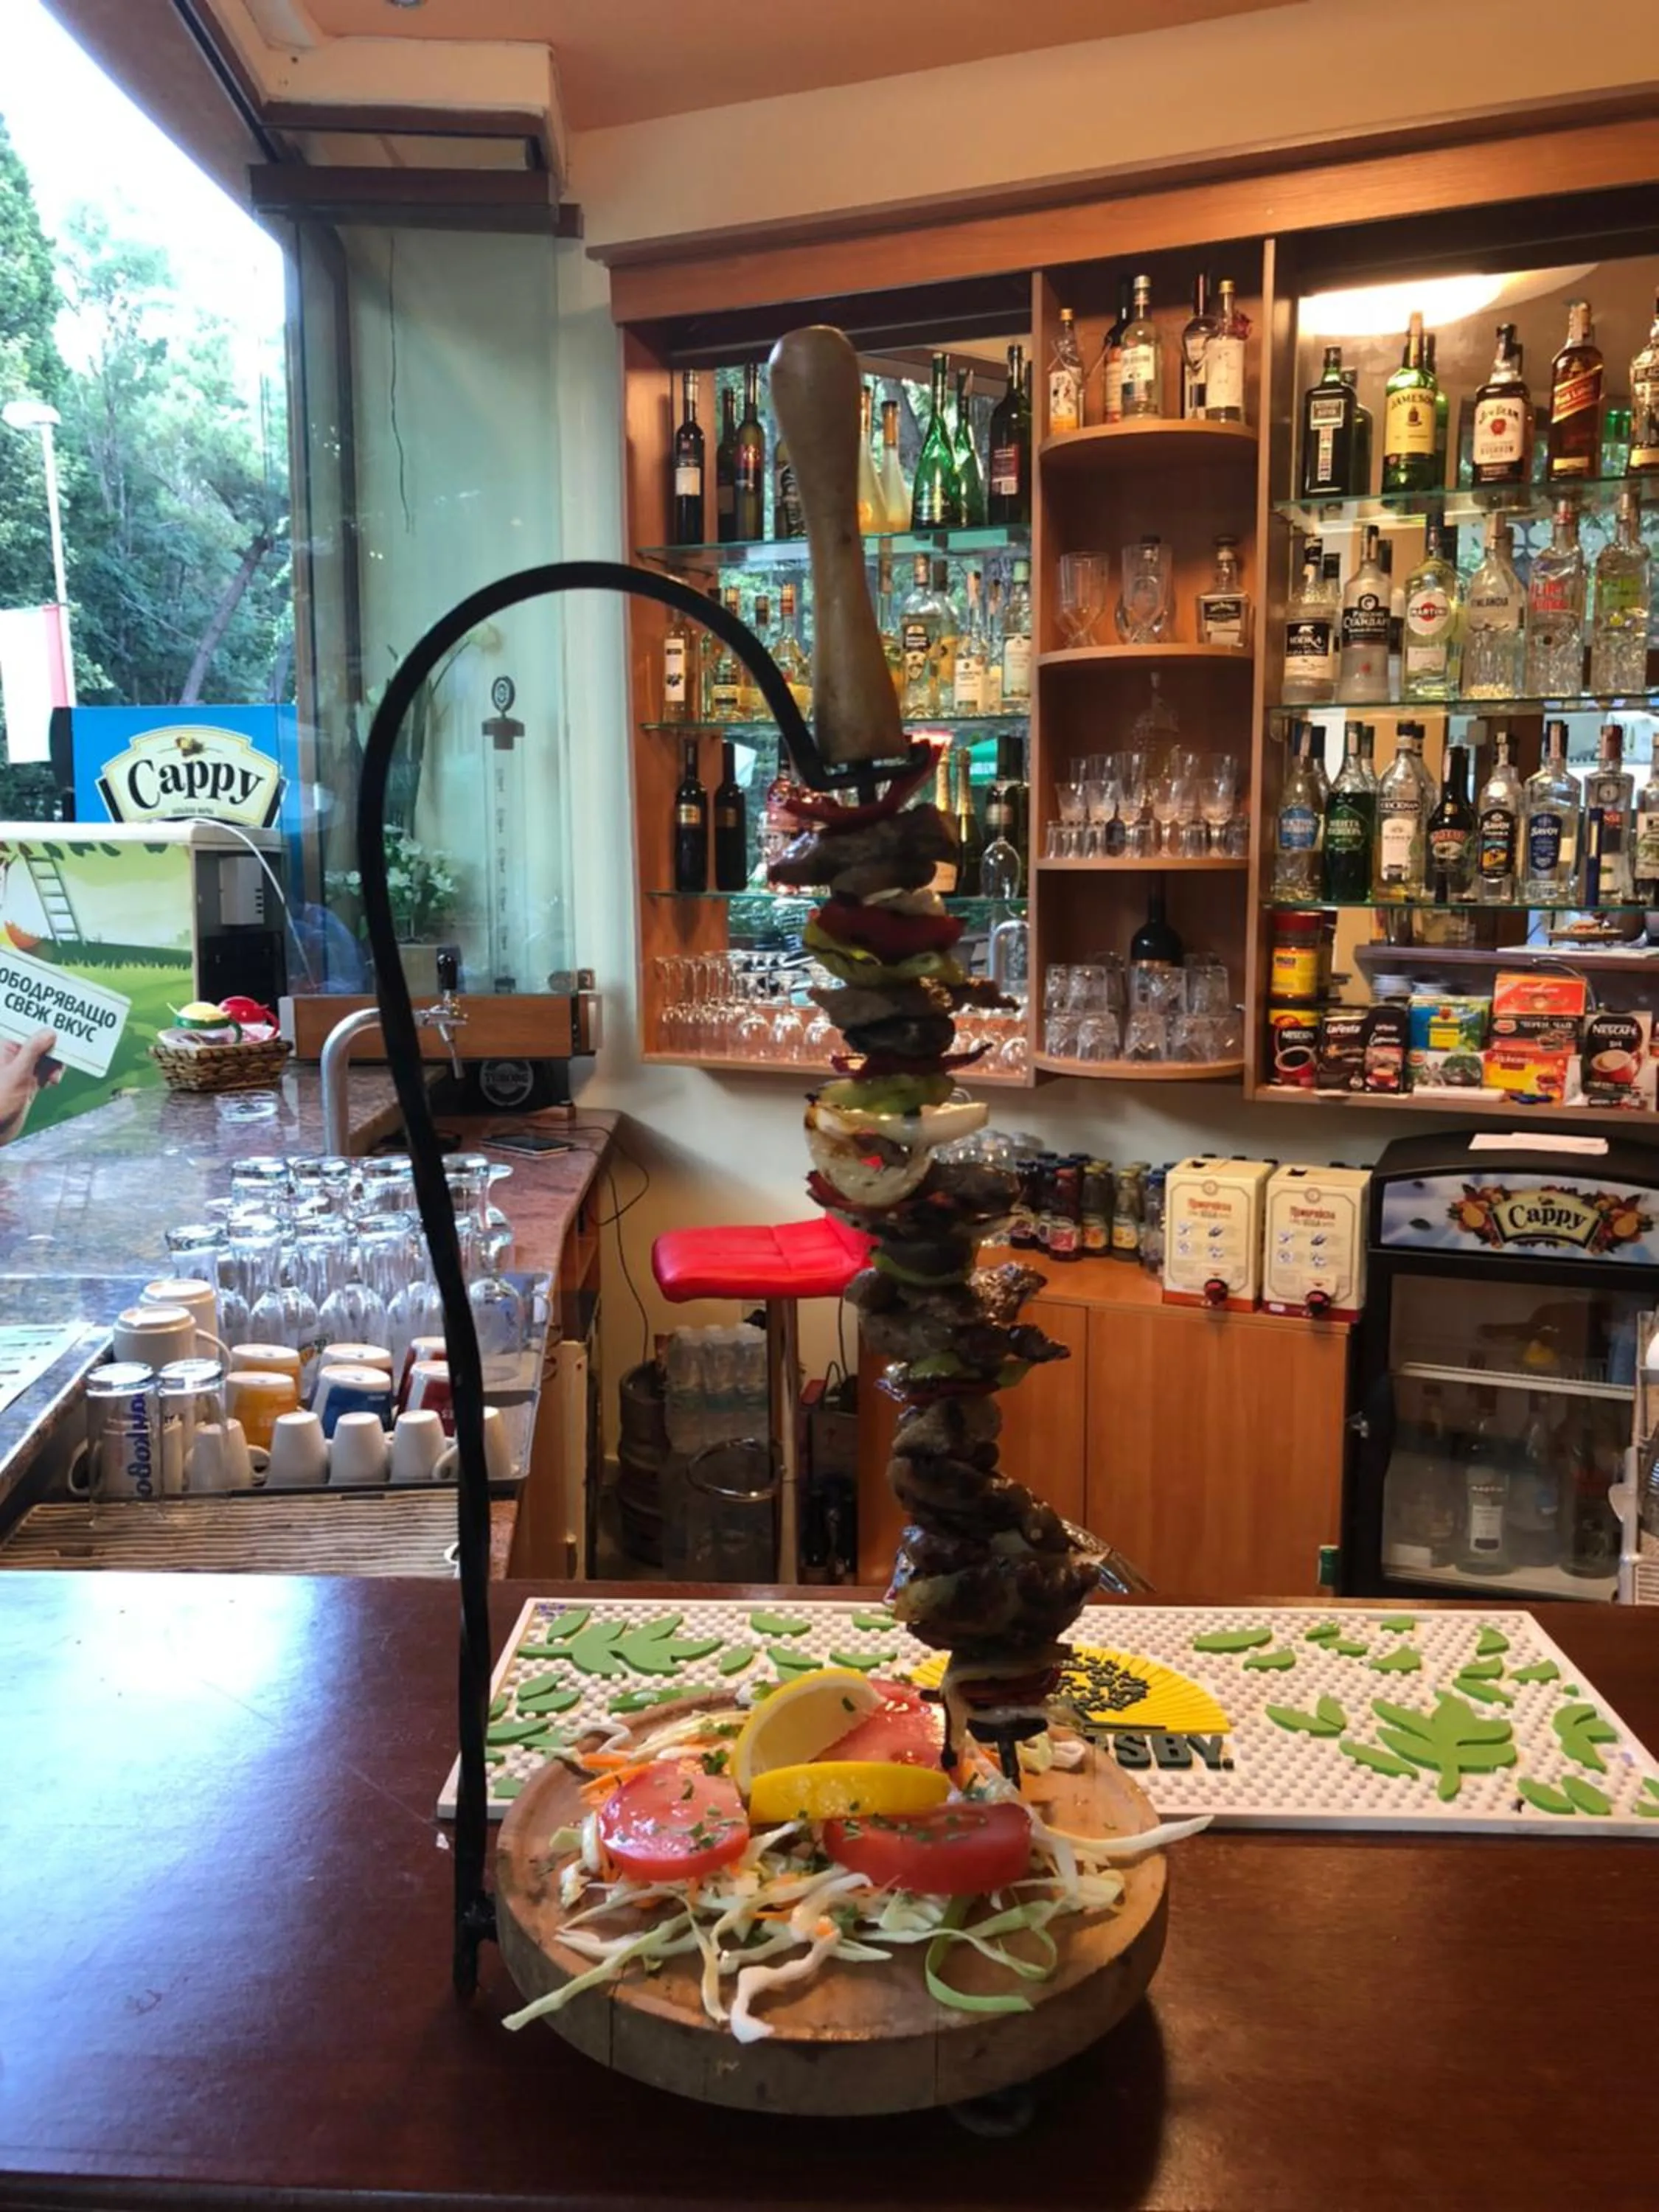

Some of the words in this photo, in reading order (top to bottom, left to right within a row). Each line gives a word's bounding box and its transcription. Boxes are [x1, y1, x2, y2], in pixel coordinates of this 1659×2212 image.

[128, 759, 265, 810] Cappy
[0, 967, 116, 1029] ОБОДРЯВАЩО
[4, 992, 52, 1024] СВЕЖ
[53, 1012, 97, 1043] ВКУС
[1508, 1204, 1587, 1229] Cappy
